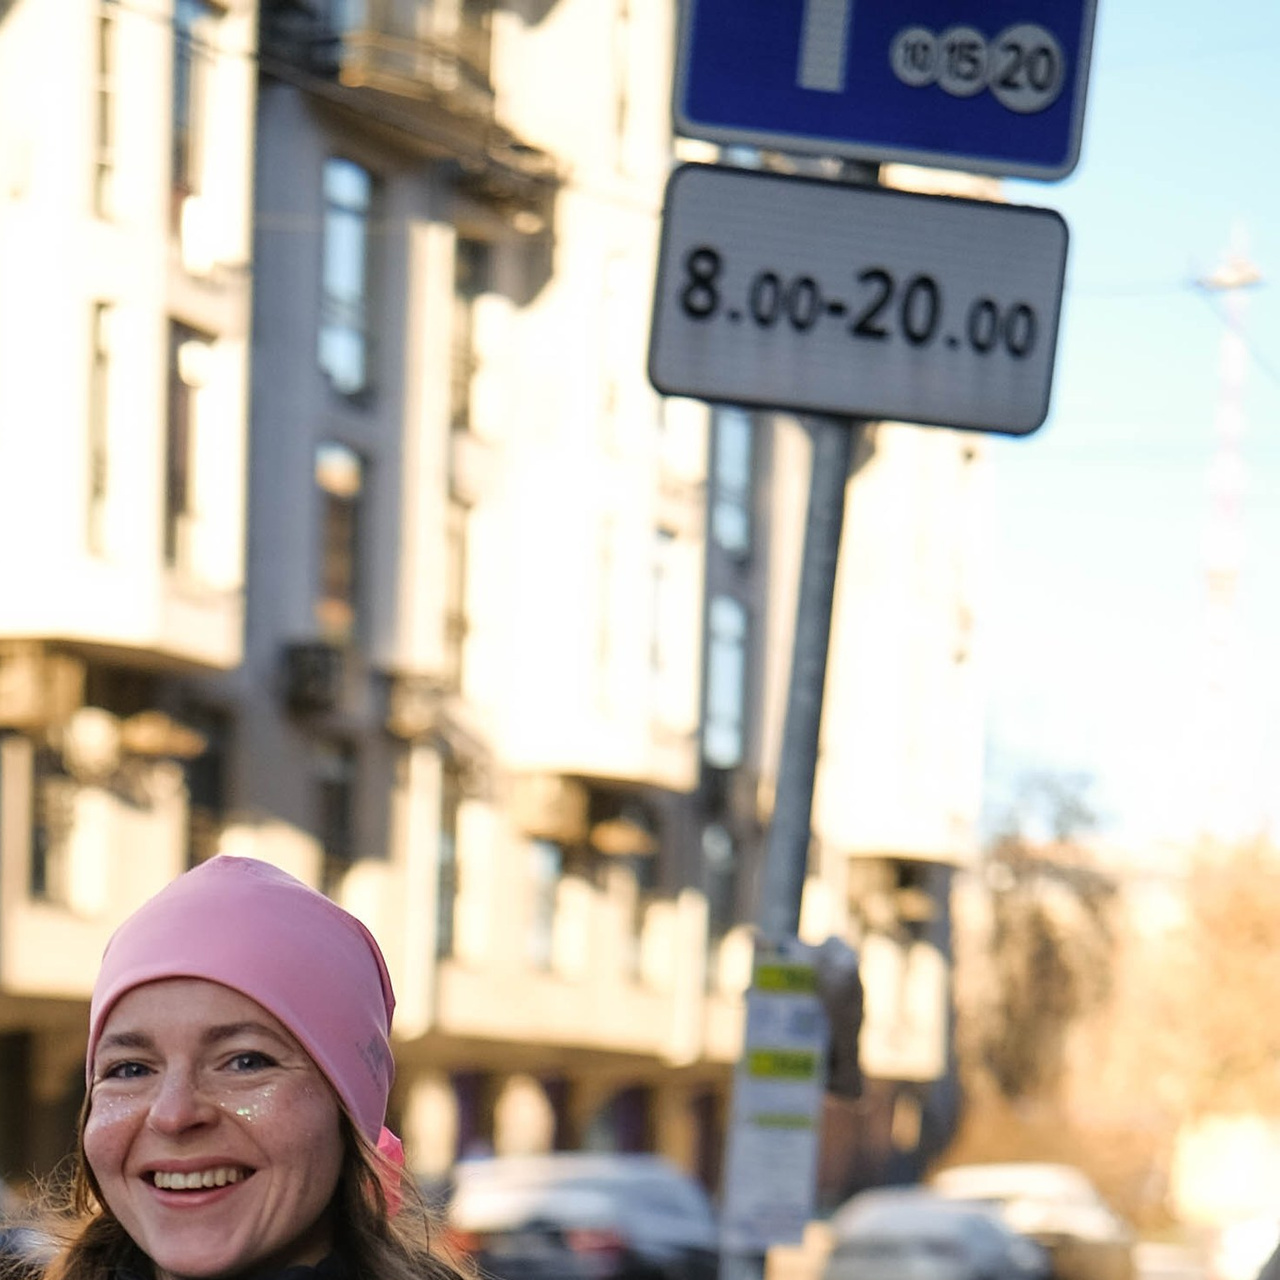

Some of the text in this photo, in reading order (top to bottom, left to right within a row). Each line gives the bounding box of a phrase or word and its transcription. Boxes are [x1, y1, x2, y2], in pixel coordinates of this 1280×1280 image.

[946, 41, 981, 81] 15
[997, 42, 1057, 93] 20
[680, 246, 1038, 360] 8.00-20.00
